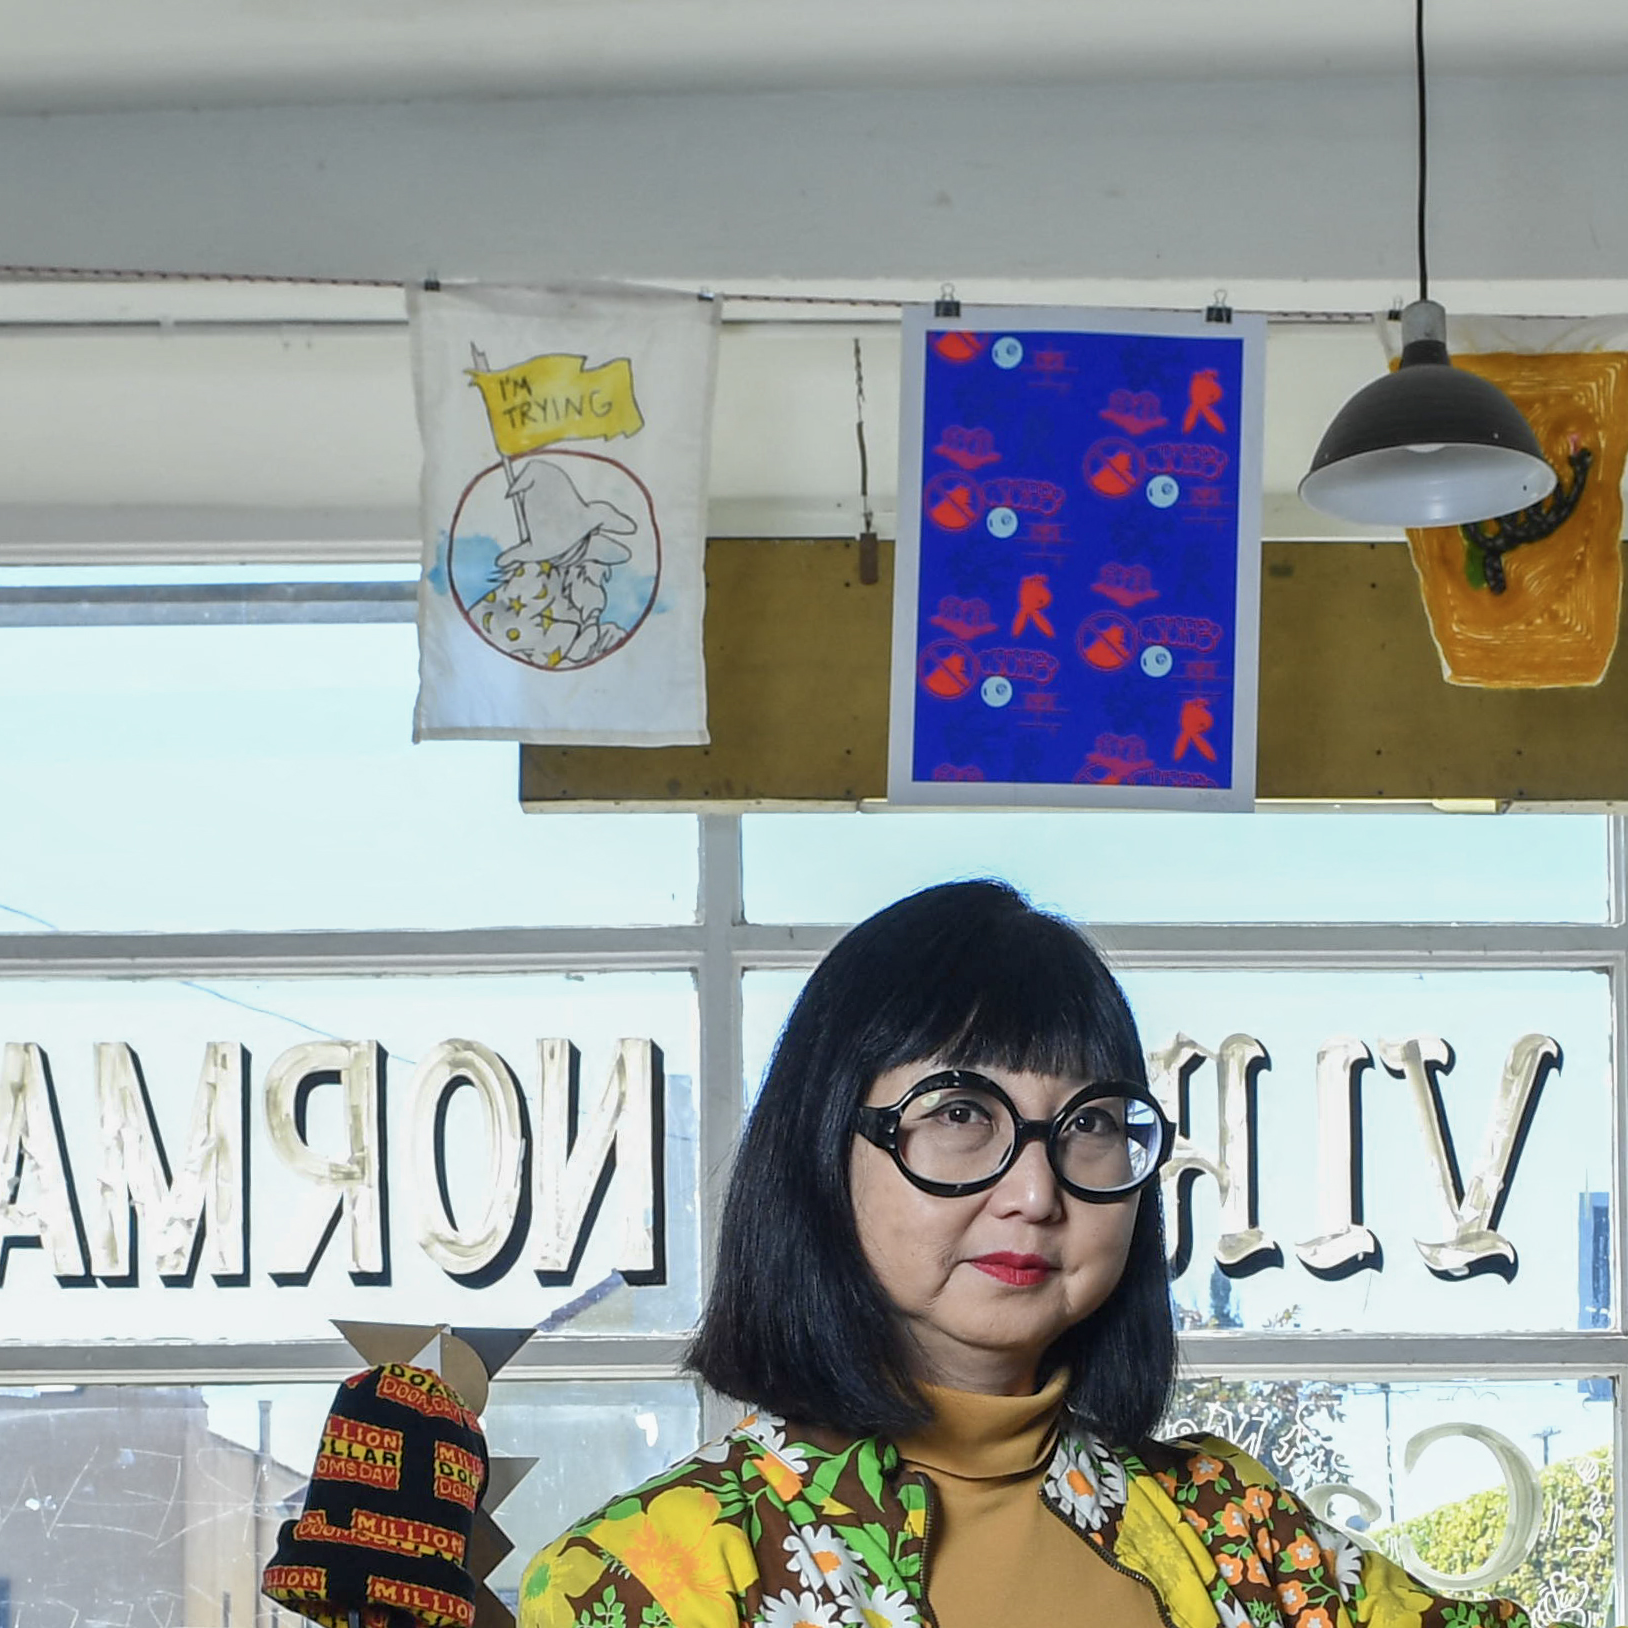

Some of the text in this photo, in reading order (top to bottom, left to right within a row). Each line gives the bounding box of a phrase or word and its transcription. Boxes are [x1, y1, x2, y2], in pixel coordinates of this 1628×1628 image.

[499, 375, 533, 402] I'M
[503, 389, 613, 429] TRYING
[326, 1419, 397, 1449] LLION
[317, 1457, 395, 1483] OMSDAY
[357, 1514, 463, 1554] MILLION
[373, 1581, 470, 1620] MILLIO
